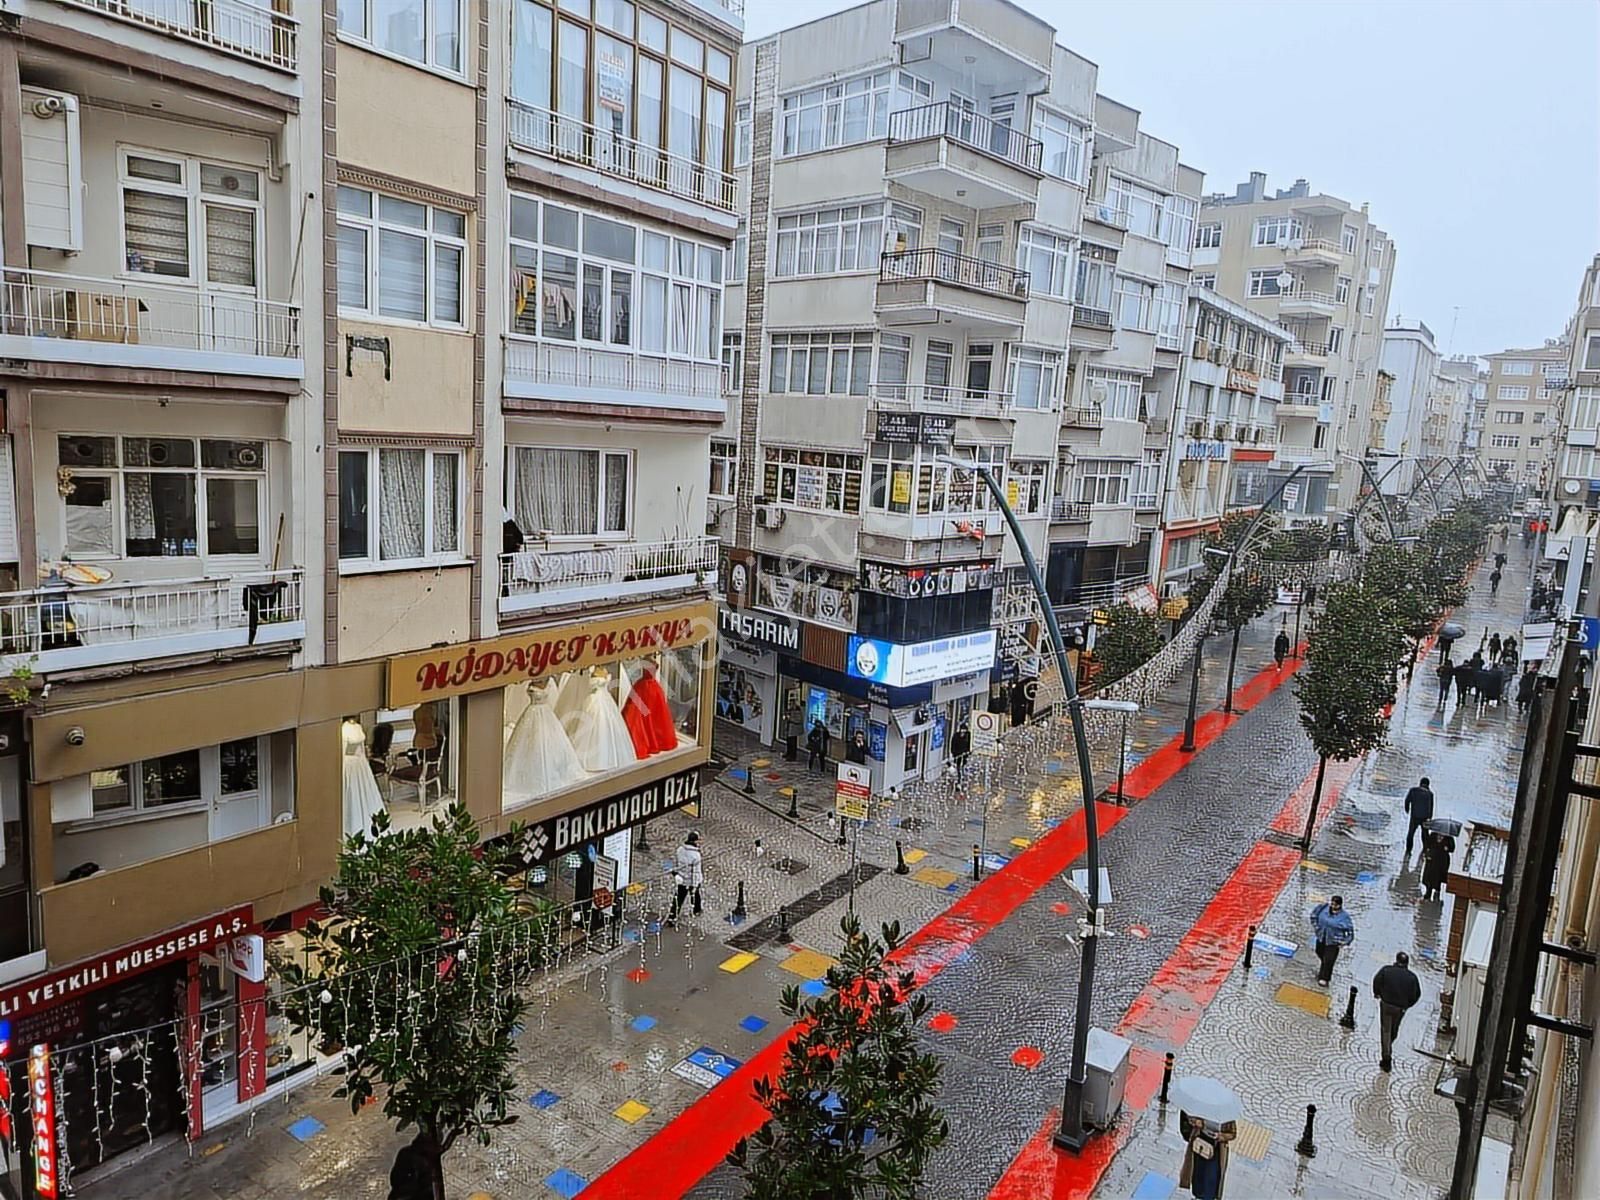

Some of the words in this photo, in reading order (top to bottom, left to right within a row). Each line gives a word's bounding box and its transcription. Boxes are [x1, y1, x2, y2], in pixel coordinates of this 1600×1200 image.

[719, 608, 798, 649] TASARIM
[416, 633, 592, 692] HİDAYET
[554, 786, 658, 851] BAKLAVACI
[27, 961, 109, 1005] YETKİLİ
[115, 928, 208, 975] MÜESSESE
[214, 916, 248, 939] A.Ş.
[32, 1044, 52, 1190] EXCHANGE
